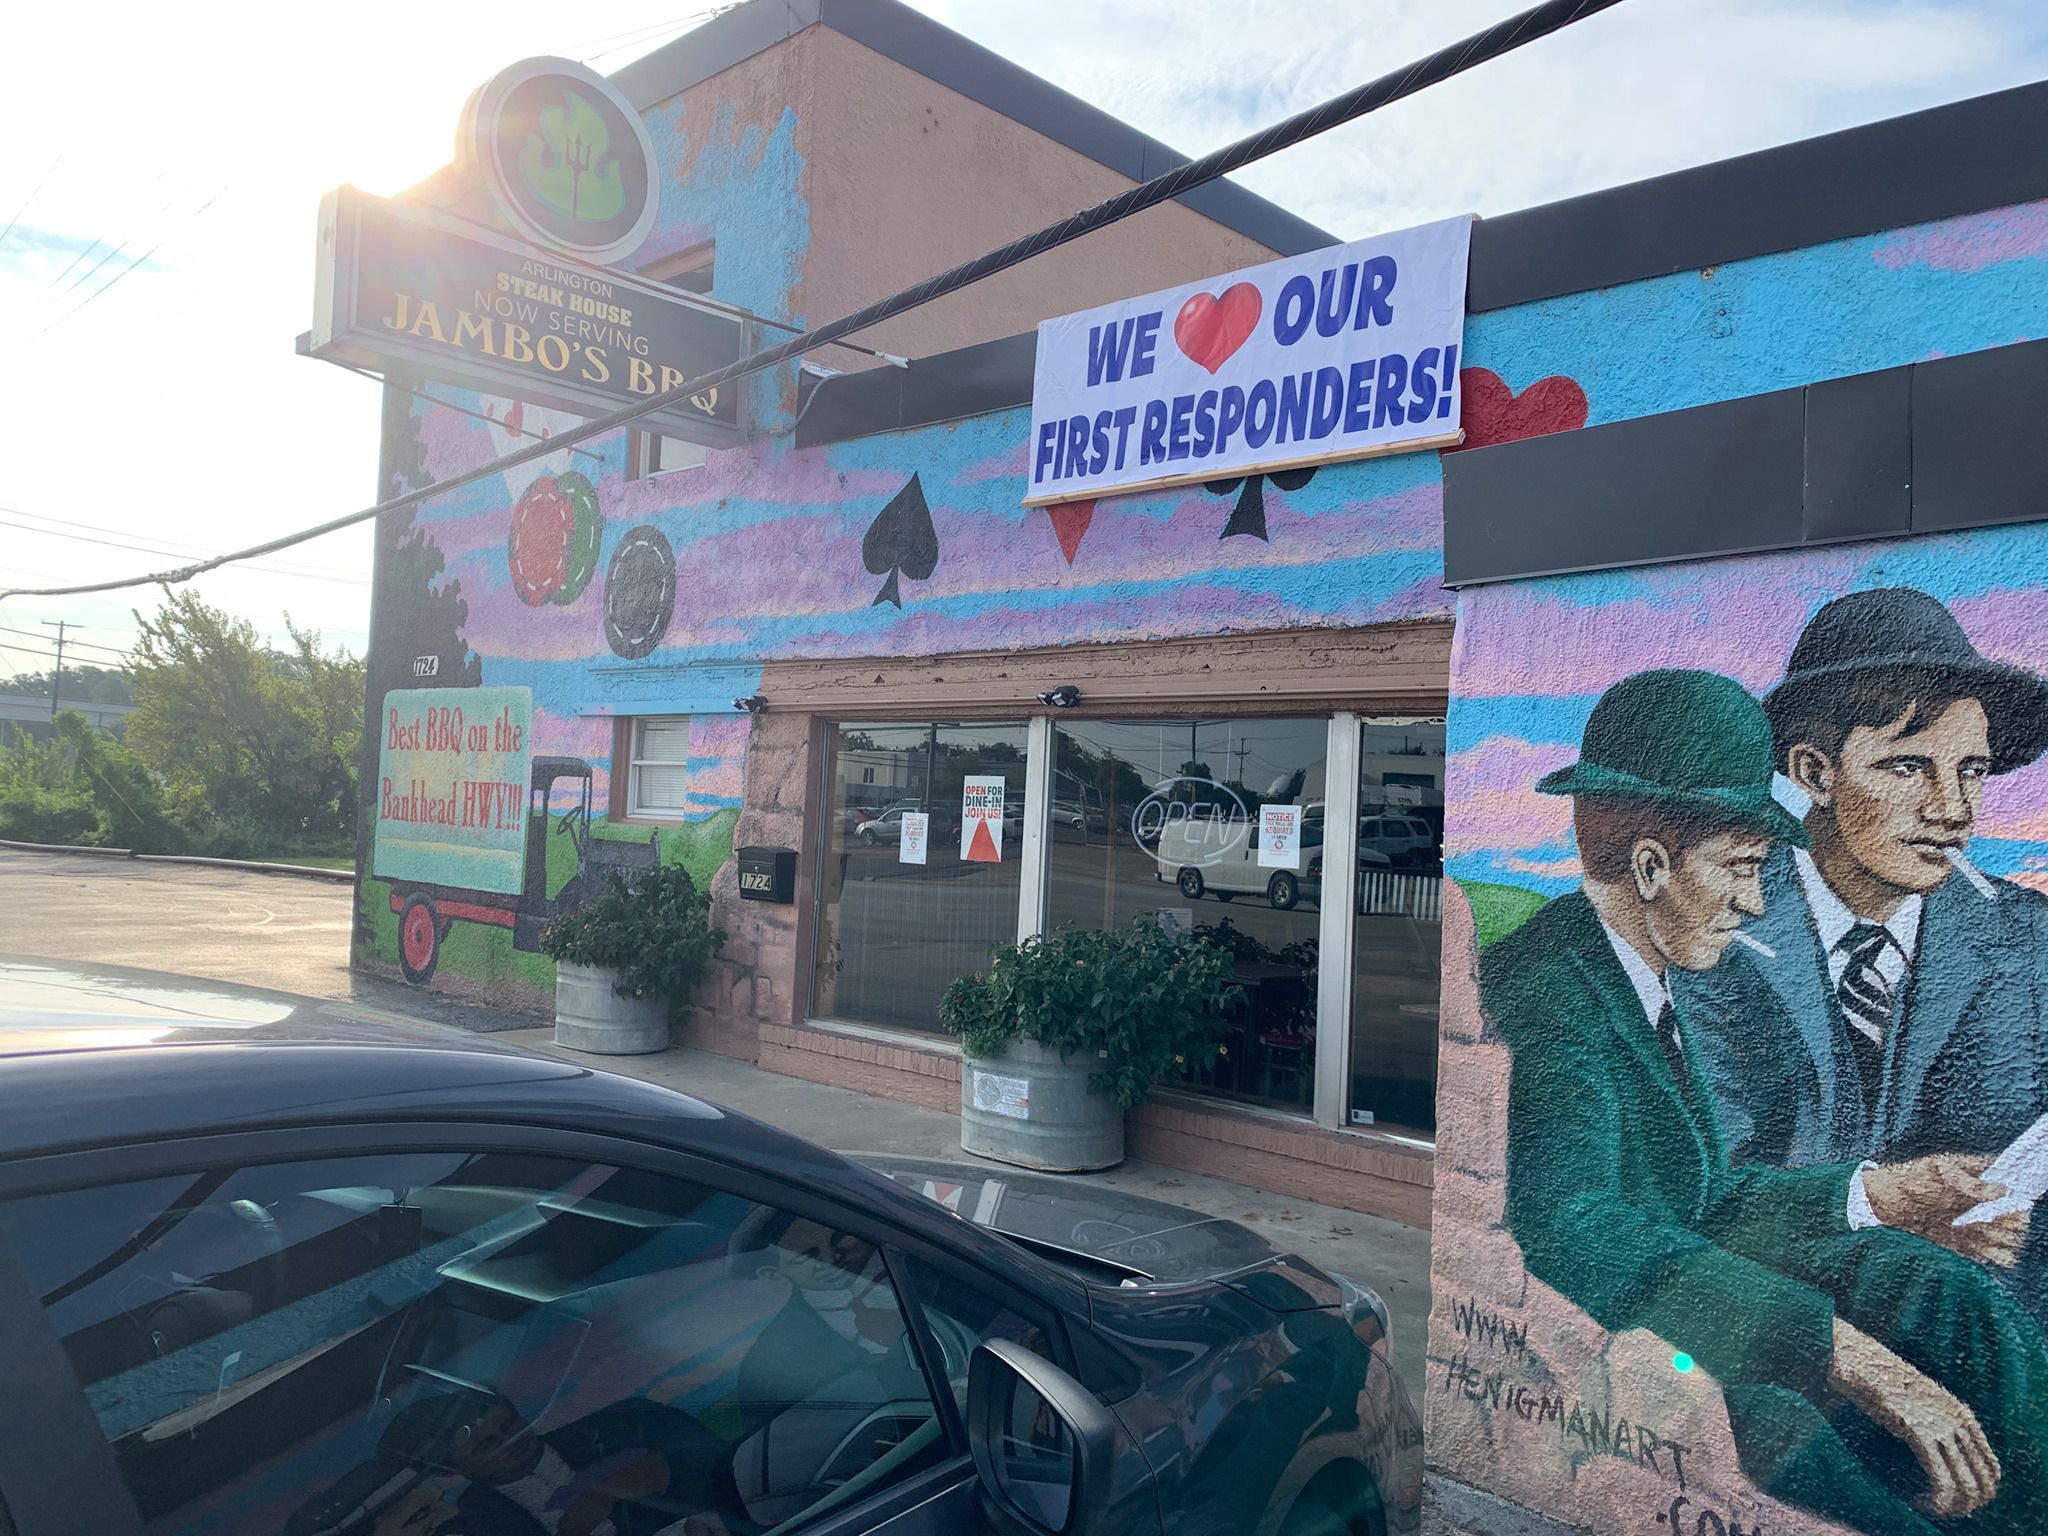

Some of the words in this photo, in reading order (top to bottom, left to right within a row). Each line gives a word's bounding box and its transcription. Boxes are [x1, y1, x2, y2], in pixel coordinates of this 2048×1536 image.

[496, 271, 564, 308] STEAK
[569, 292, 633, 329] HOUSE
[521, 259, 613, 299] ARLINGTON
[382, 291, 611, 384] JAMBO'S
[473, 288, 539, 325] NOW
[548, 310, 650, 356] SERVING
[1086, 310, 1163, 388] WE
[1272, 254, 1398, 347] OUR
[1034, 404, 1137, 484] FIRST
[1139, 344, 1458, 466] RESPONDERS!
[414, 656, 436, 676] 1724
[387, 707, 421, 752] Best
[425, 705, 464, 757] BBQ
[467, 723, 488, 752] on
[494, 705, 523, 753] the
[380, 776, 457, 827] Bankhead
[461, 780, 523, 832] HWY!!!
[964, 807, 986, 818] JOIN
[988, 808, 1001, 819] US!
[965, 785, 986, 796] OPEN
[987, 786, 1003, 796] FOR
[965, 795, 1002, 808] DINE-IN
[1138, 800, 1238, 846] OPEN
[1266, 813, 1294, 821] NOTICE
[743, 874, 771, 890] 1724
